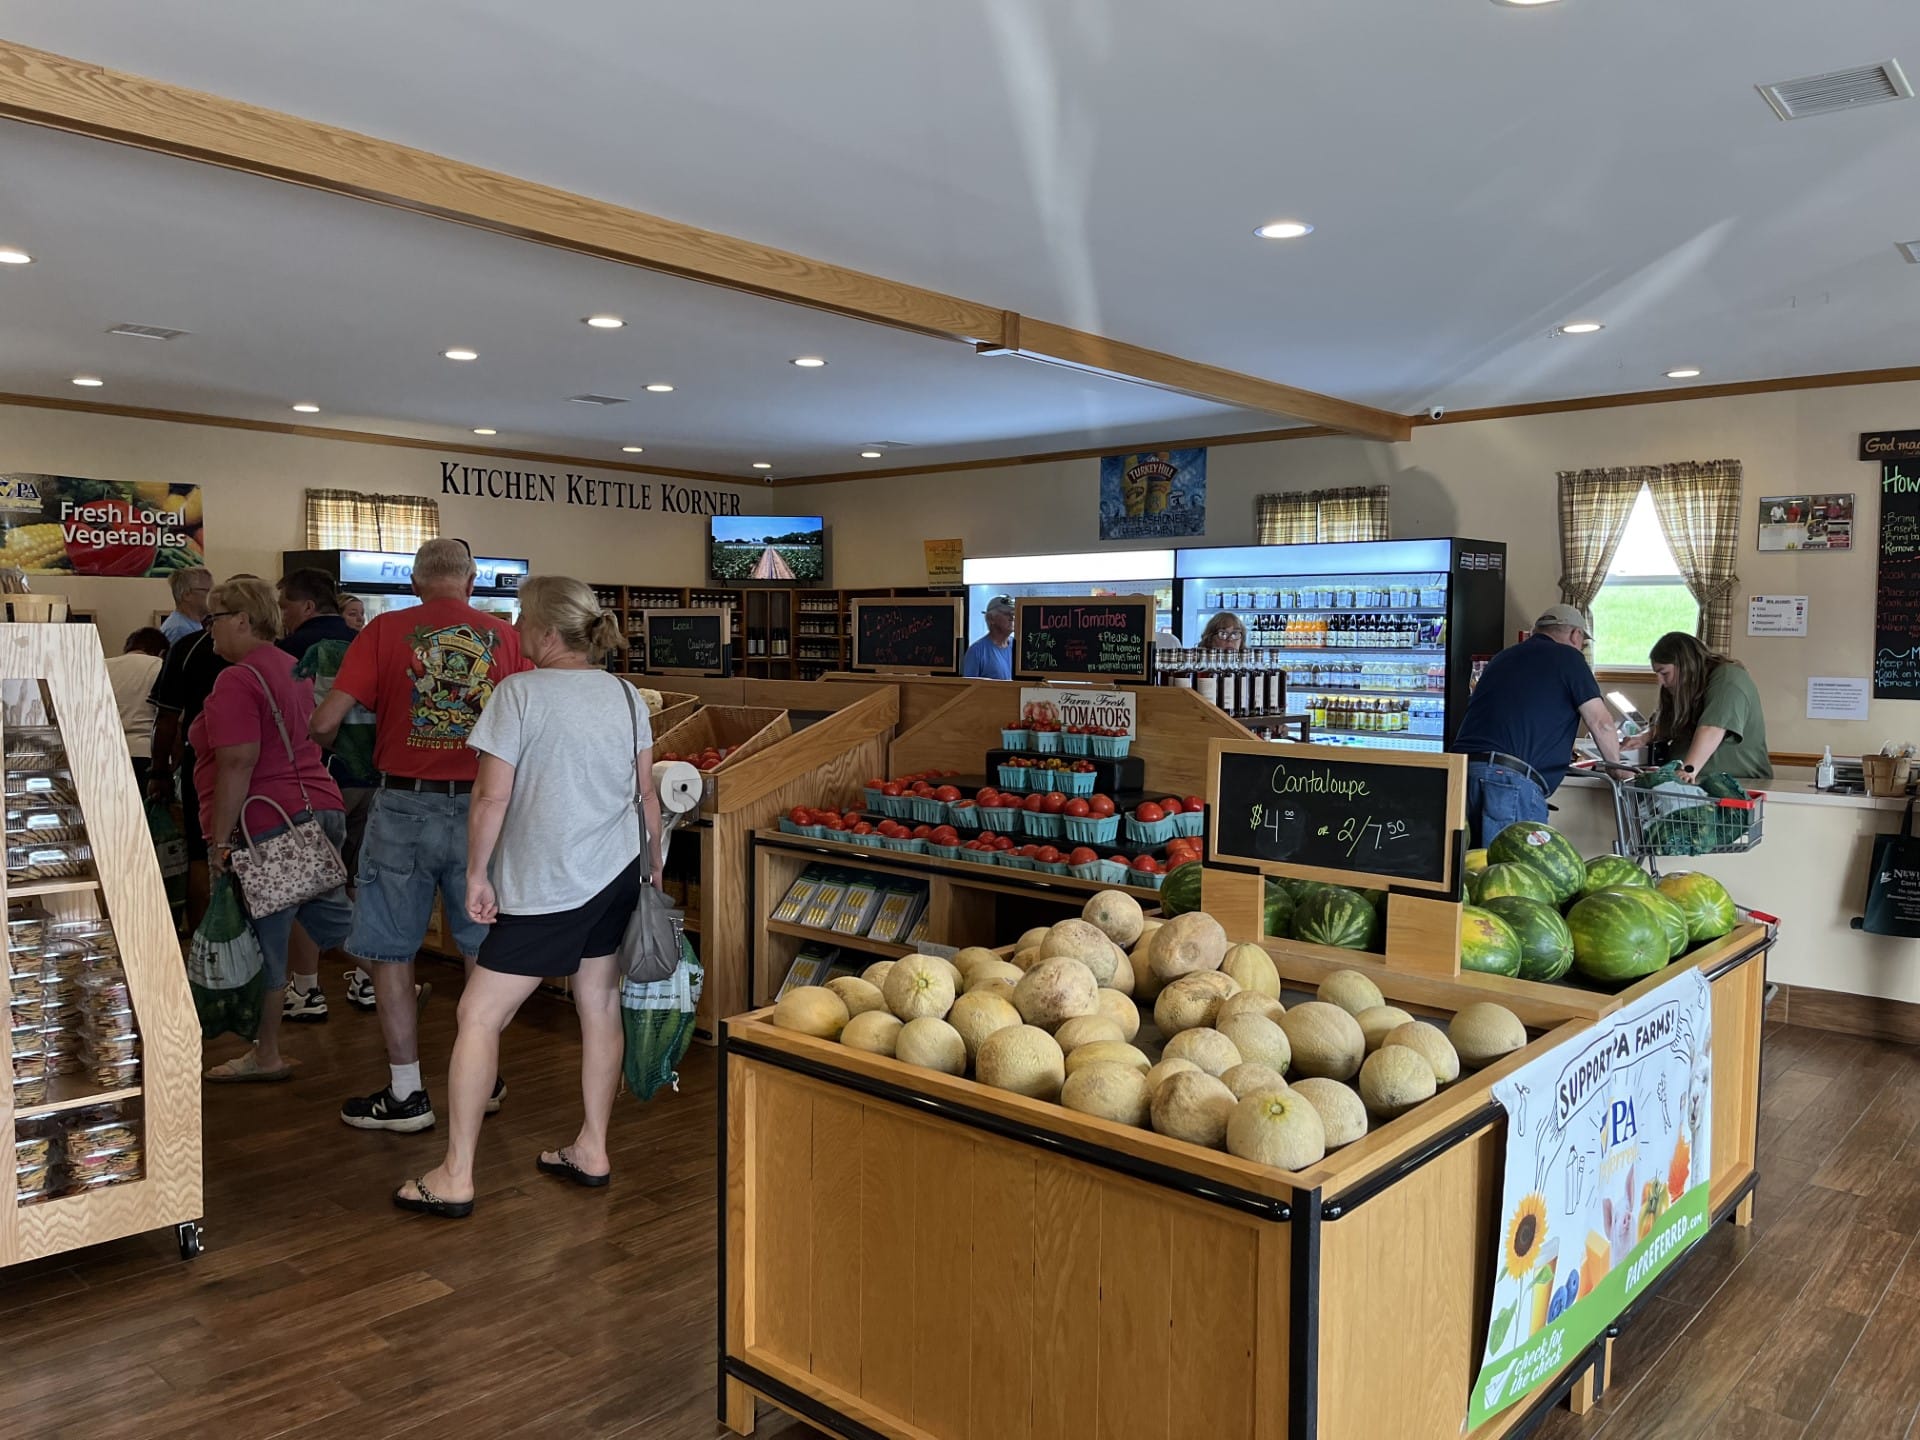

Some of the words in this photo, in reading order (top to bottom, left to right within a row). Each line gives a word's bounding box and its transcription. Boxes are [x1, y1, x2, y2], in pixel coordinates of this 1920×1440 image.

[1865, 437, 1896, 453] God
[1129, 463, 1159, 480] TURKEY
[1159, 464, 1174, 478] HILL
[1883, 465, 1920, 493] How
[440, 461, 555, 503] KITCHEN
[566, 474, 652, 510] KETTLE
[661, 483, 741, 516] KORNER
[60, 502, 122, 524] Fresh
[128, 505, 185, 527] Local
[61, 524, 186, 549] Vegetables
[381, 561, 412, 577] Fro
[1040, 606, 1072, 629] Local
[1074, 608, 1127, 629] Tomatoes
[1058, 692, 1091, 706] Farm
[1094, 694, 1126, 707] Fresh
[1061, 705, 1131, 728] TOMATOES
[407, 737, 441, 751] STEPPED
[1271, 764, 1371, 801] Cantaloupe
[1559, 1045, 1615, 1120] SUPPORT
[1635, 1009, 1675, 1053] FARMS!
[1611, 1095, 1637, 1147] PA
[1515, 1337, 1548, 1375] check
[1546, 1328, 1565, 1357] for
[1509, 1372, 1531, 1396] the
[1531, 1343, 1563, 1382] check
